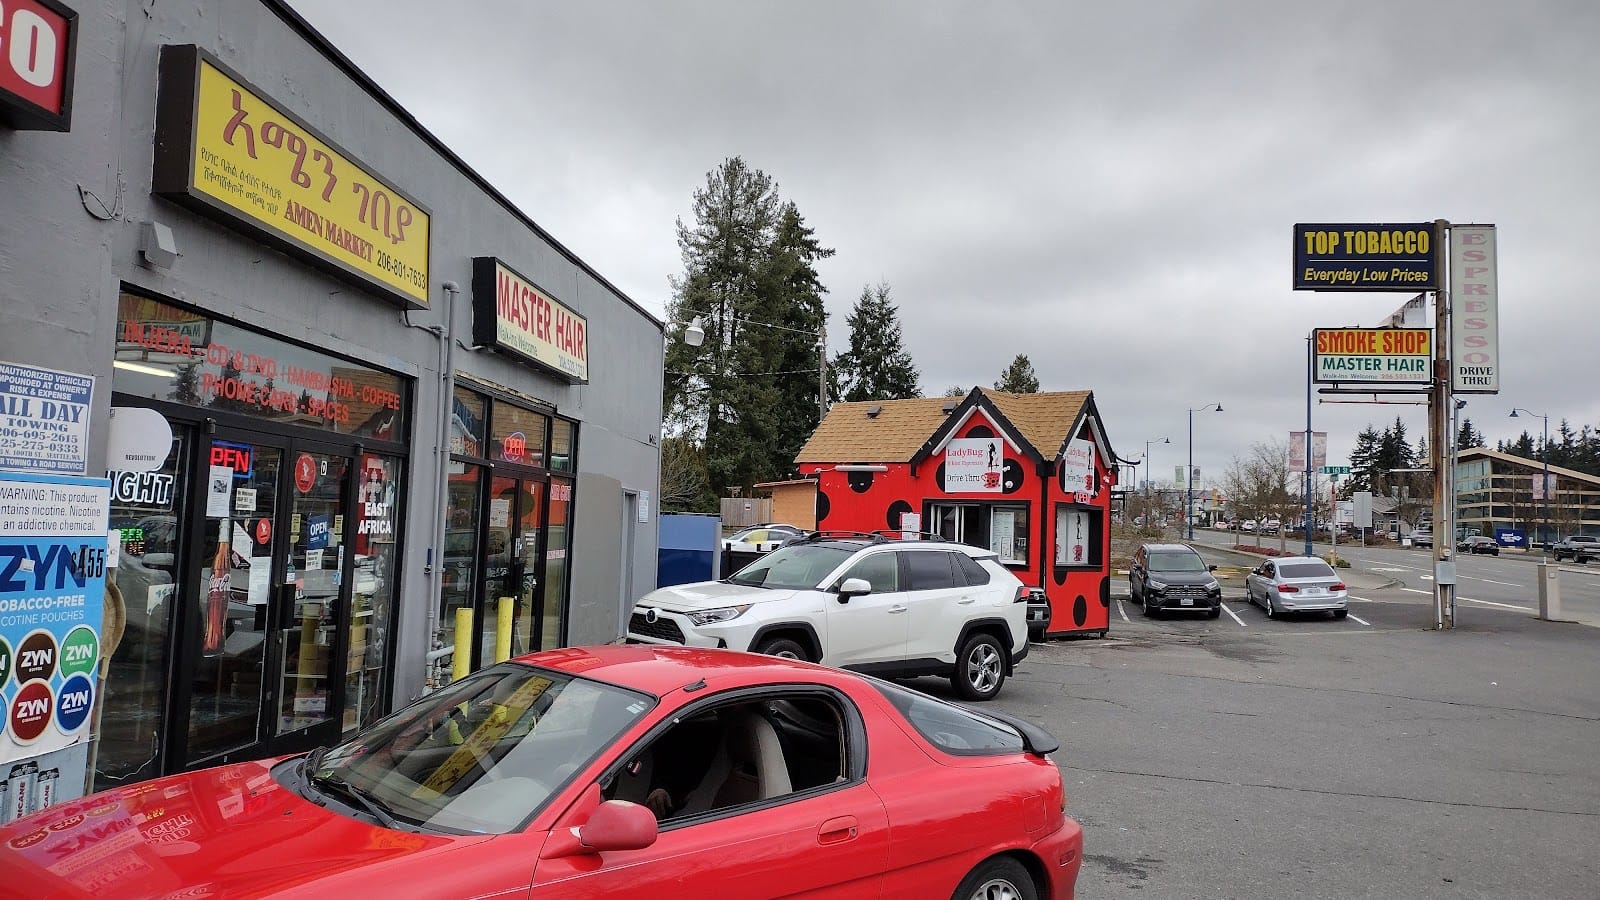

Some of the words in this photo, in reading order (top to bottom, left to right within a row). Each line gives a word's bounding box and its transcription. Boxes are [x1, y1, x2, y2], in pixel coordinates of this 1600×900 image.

[0, 0, 56, 87] O
[284, 199, 324, 236] AMEN
[325, 219, 374, 264] MARKET
[377, 250, 426, 290] 206-801-7633
[1304, 231, 1339, 254] TOP
[1344, 231, 1429, 254] TOBACCO
[1304, 268, 1360, 284] Everyday
[1362, 268, 1388, 281] Low
[1391, 268, 1428, 281] Prices
[1462, 233, 1489, 365] ESPRESSO
[498, 271, 551, 344] MASTER
[556, 308, 585, 361] HAIR
[1317, 331, 1377, 353] SMOKE
[1382, 331, 1427, 353] SHOP
[125, 320, 193, 360] INJERA
[207, 343, 229, 366] CD
[233, 350, 243, 371] &
[246, 354, 277, 379] DVD
[287, 365, 354, 398] HAMBASHA
[362, 385, 400, 411] COFFEE
[1322, 357, 1381, 370] MASTER
[1387, 358, 1425, 372] HAIR
[1459, 367, 1493, 376] DRIVE
[55, 375, 91, 387] VEHICLES
[1461, 376, 1492, 385] THRU
[9, 385, 28, 395] RISK
[38, 389, 72, 401] EXPENSE
[54, 383, 87, 395] OWNER'S
[202, 372, 256, 404] PHONE
[260, 386, 299, 412] CARD
[308, 397, 349, 423] SPICES
[0, 395, 33, 418] ALL
[40, 400, 84, 423] DAY
[7, 418, 68, 432] TOWING
[504, 437, 526, 457] OPEN
[947, 448, 983, 458] LadyBug
[7, 458, 31, 467] TOWING
[57, 461, 84, 470] SERVICE
[0, 487, 47, 501] WARNING:
[50, 489, 66, 503] This
[68, 492, 98, 504] product
[1, 505, 30, 515] ntains
[32, 506, 67, 517] nicotine.
[69, 505, 101, 517] Nicotine
[364, 502, 388, 517] EAST
[3, 520, 14, 530] an
[17, 519, 58, 531] addictive
[59, 520, 96, 531] chemical.
[310, 521, 328, 536] OPEN
[358, 520, 391, 534] AFRICA
[0, 545, 88, 592] ZYN
[41, 610, 84, 624] POUCHES
[21, 649, 52, 668] ZYN
[66, 643, 93, 662] ZYN
[17, 697, 49, 718] ZYN
[61, 690, 89, 710] ZYN
